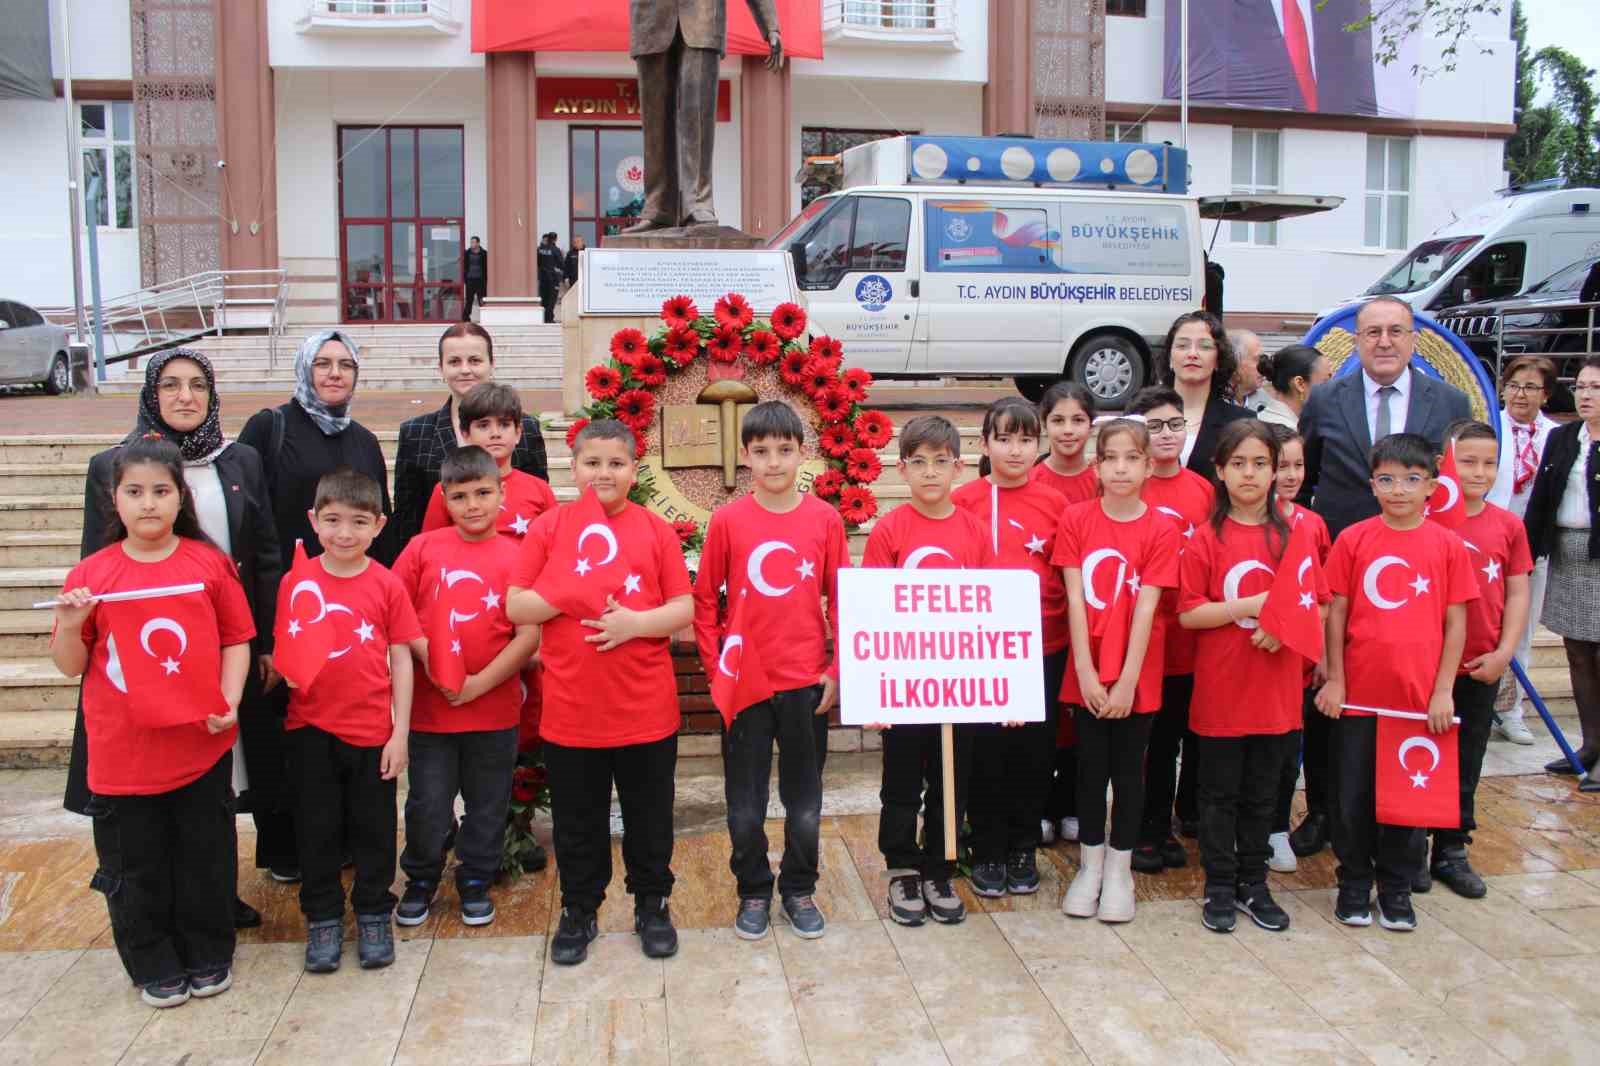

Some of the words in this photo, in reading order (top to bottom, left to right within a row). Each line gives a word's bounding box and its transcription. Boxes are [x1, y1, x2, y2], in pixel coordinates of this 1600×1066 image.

[553, 99, 617, 114] AYDIN
[1071, 224, 1179, 242] BÜYÜKŞEHİR
[957, 285, 980, 301] T.C.
[985, 286, 1026, 300] AYDIN
[1030, 283, 1116, 303] BÜYÜKŞEHİR
[1119, 287, 1193, 303] BELEDİYESİ
[893, 584, 993, 613] EFELER
[852, 625, 1033, 661] CUMHURİYET
[879, 673, 1009, 708] İLKOKULU
